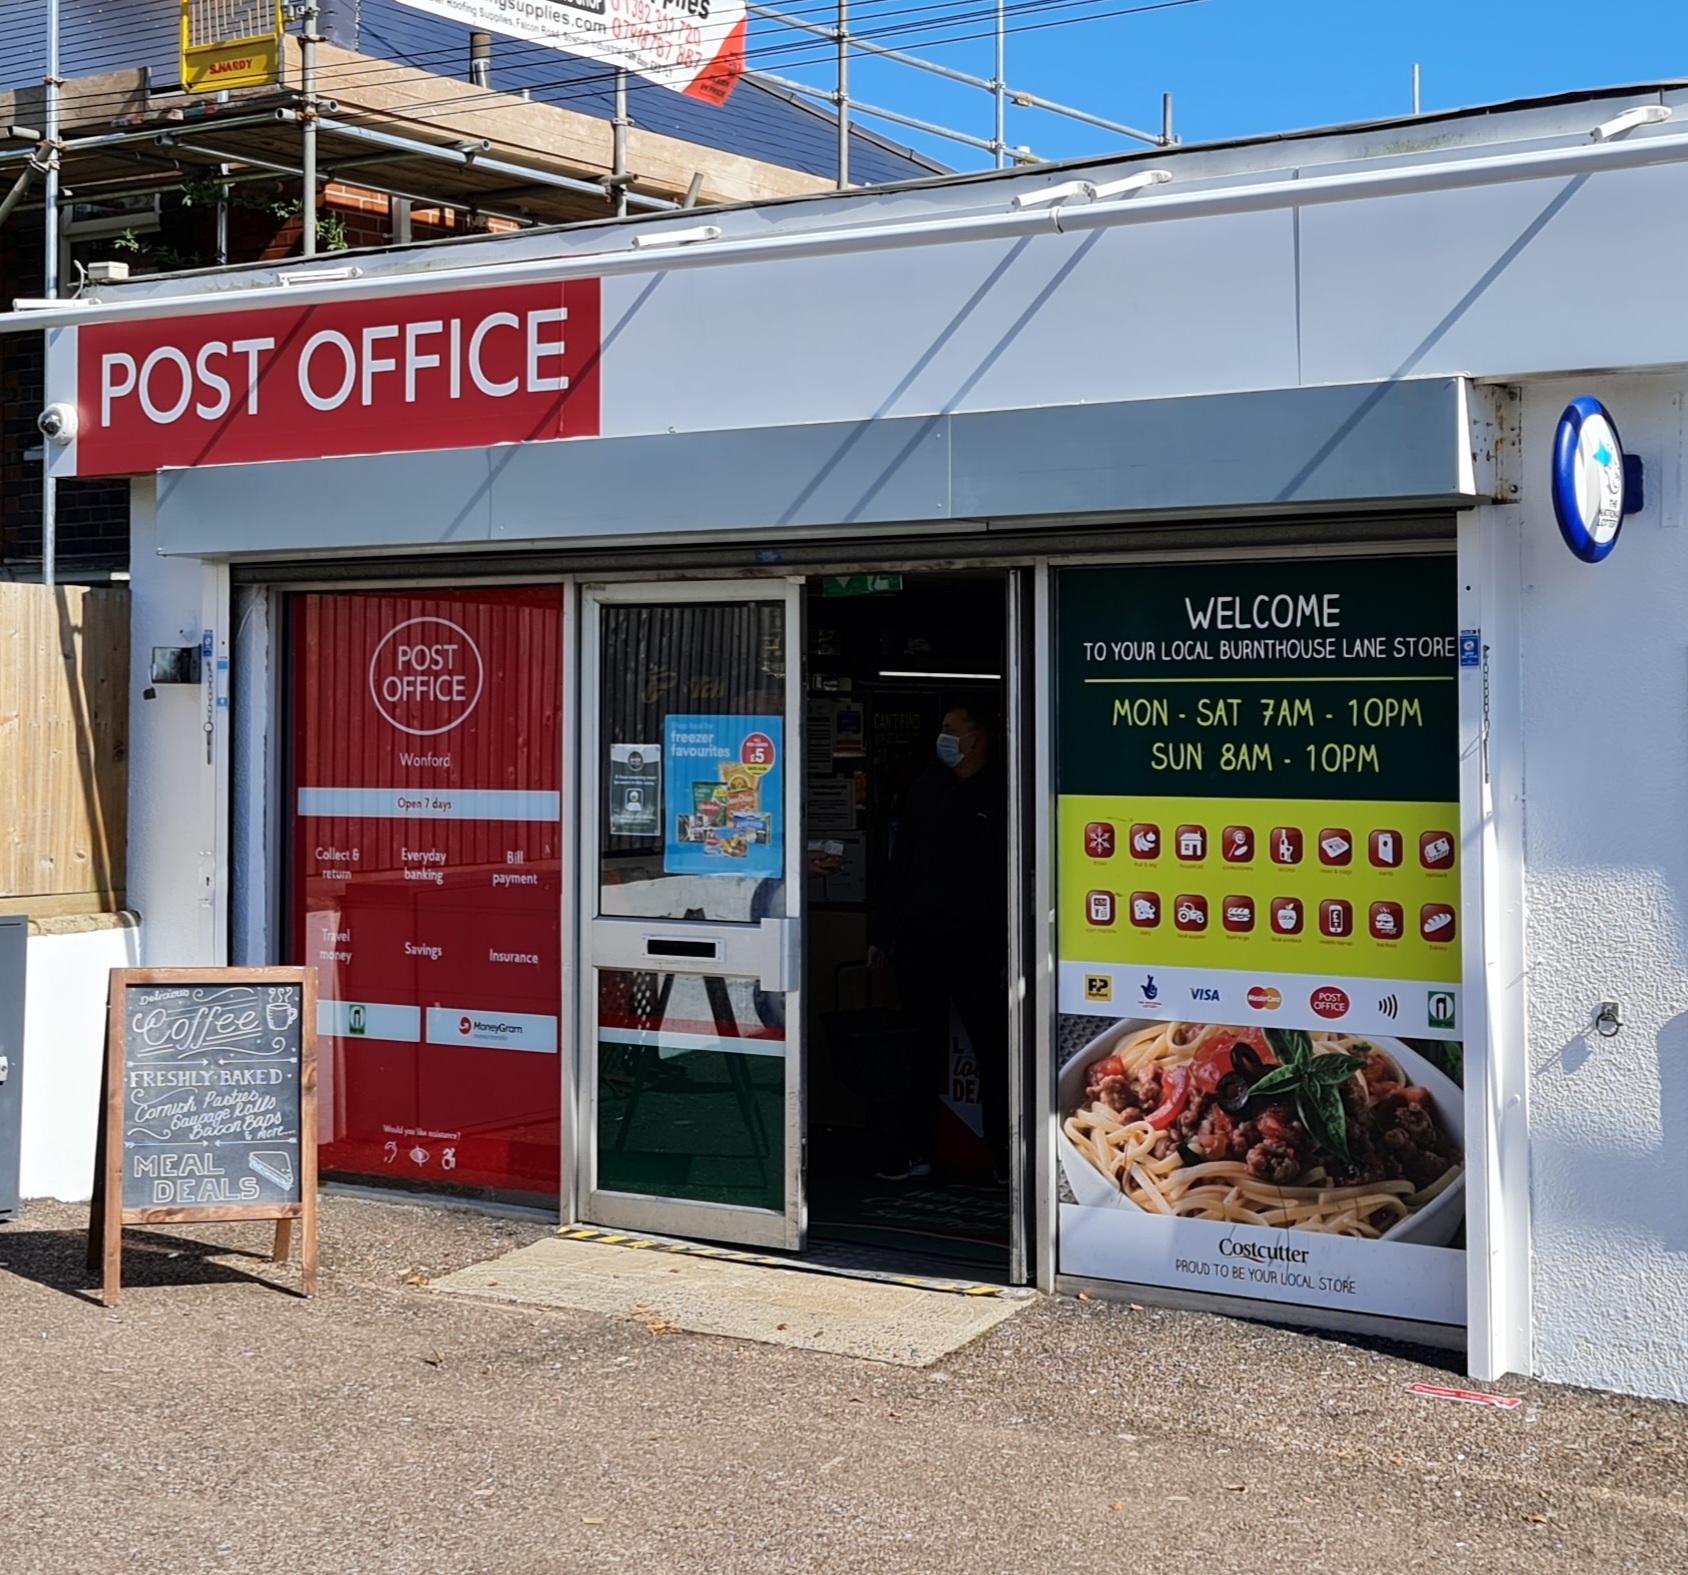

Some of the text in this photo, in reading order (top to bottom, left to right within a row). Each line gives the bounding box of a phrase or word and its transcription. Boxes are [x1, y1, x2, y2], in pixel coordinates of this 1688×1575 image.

[101, 307, 569, 427] POST OFFICE
[1184, 593, 1341, 630] WELCOME
[398, 644, 458, 671] POST
[1083, 636, 1456, 662] TO YOUR LOCAL BURNTHOUSE LANE STORE
[383, 675, 466, 702] OFFICE
[1112, 698, 1168, 727] MON
[1196, 698, 1242, 727] SAT
[1260, 698, 1315, 727] 7AM
[1347, 697, 1423, 727] 10PM
[670, 729, 714, 744] freezer
[400, 752, 451, 767] Wonford
[670, 743, 731, 758] favourites
[1151, 742, 1202, 771] SUN
[1220, 742, 1273, 772] 8AM
[1306, 743, 1380, 773] 10PM
[397, 797, 452, 811] Open 7 days
[315, 847, 360, 861] Collect &
[401, 848, 447, 866] Everyday
[507, 851, 524, 864] Bill
[322, 868, 352, 880] return
[404, 868, 444, 885] banking
[493, 873, 538, 887] payment
[322, 928, 350, 942] Travel
[319, 951, 352, 965] money
[404, 941, 443, 960] Savings
[489, 948, 539, 964] Insurance
[139, 989, 190, 1005] Delicious
[1190, 988, 1220, 1001] VISA
[1318, 992, 1343, 1002] POST
[1314, 1002, 1345, 1012] OFFICE
[132, 1006, 259, 1050] Coffee
[473, 1021, 523, 1034] MoneyGram
[130, 1068, 283, 1088] FRESHLY BAKED
[135, 1087, 259, 1123] Cornish Pasties
[171, 1095, 276, 1130] Sausage Rolls
[189, 1110, 282, 1140] Bacon Baps
[133, 1152, 225, 1178] MEAL
[153, 1176, 261, 1204] DEALS
[1219, 1237, 1310, 1264] Costcutter
[1175, 1258, 1357, 1295] PROUD TO BE YOUR LOCAL STORE
